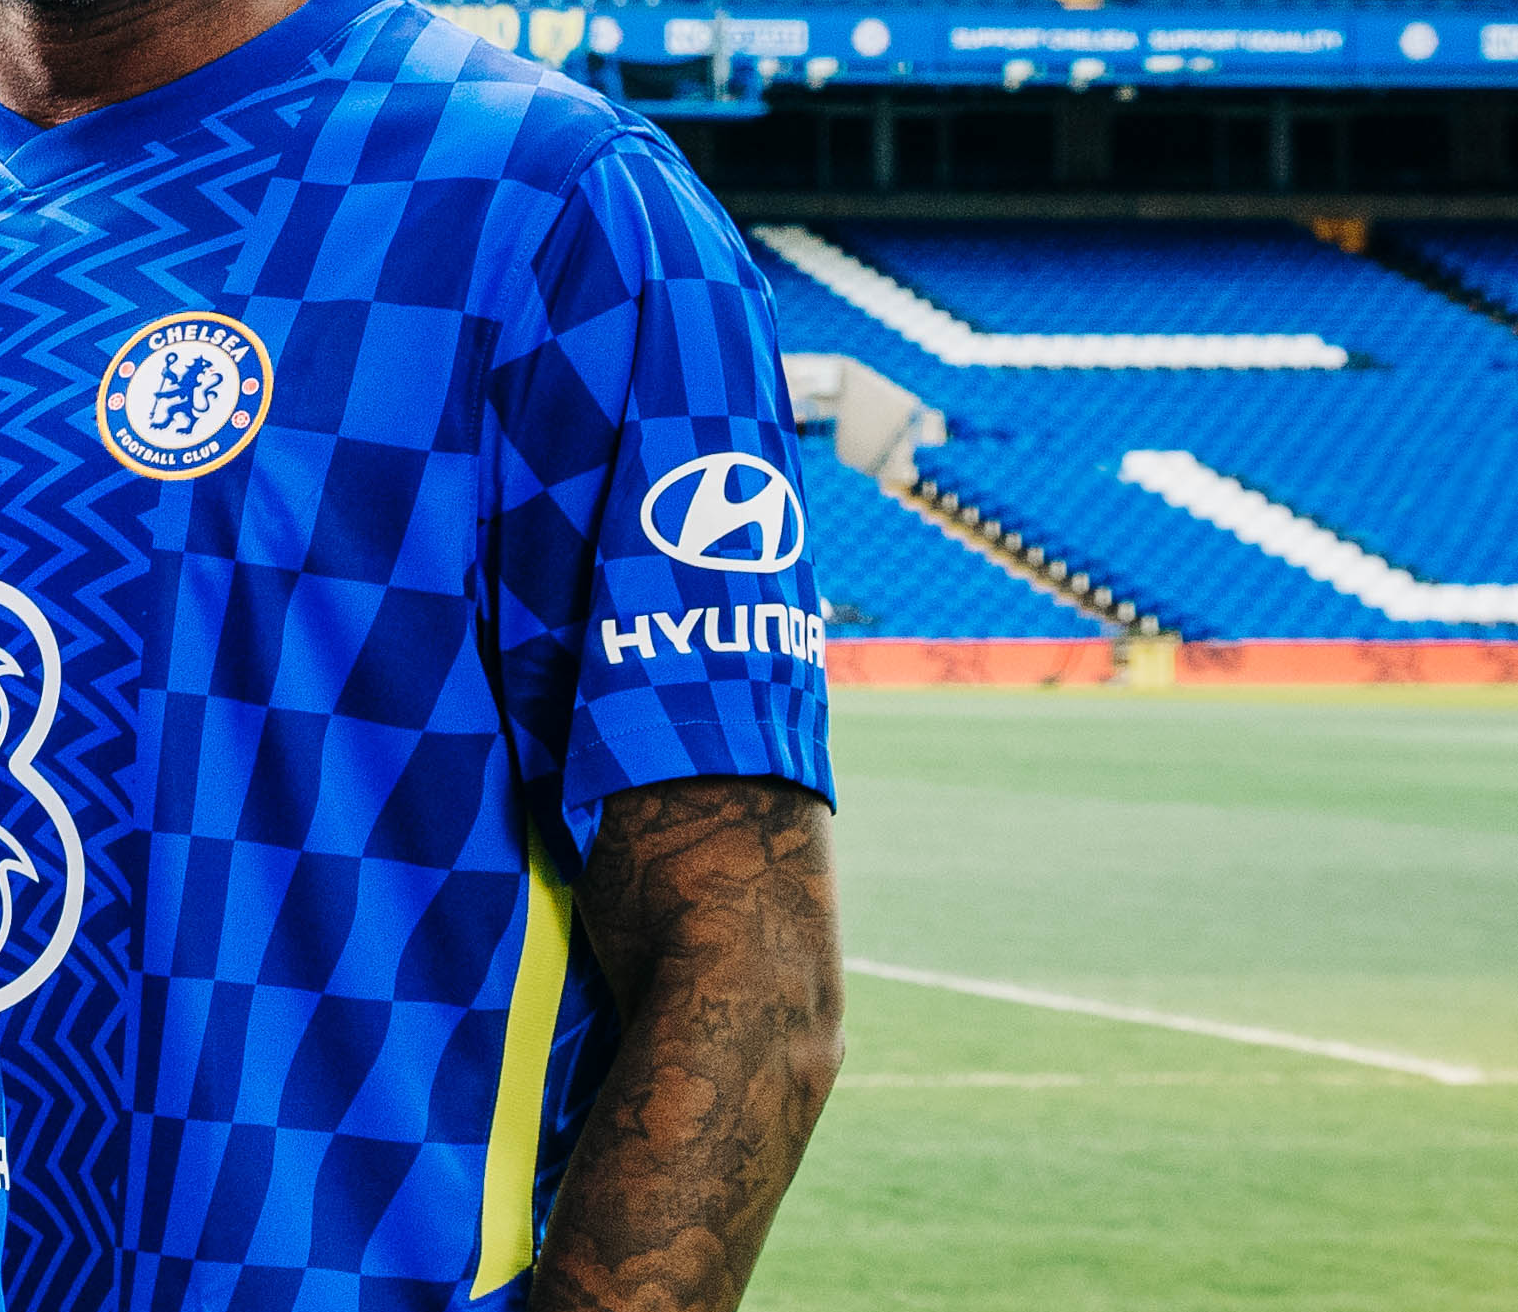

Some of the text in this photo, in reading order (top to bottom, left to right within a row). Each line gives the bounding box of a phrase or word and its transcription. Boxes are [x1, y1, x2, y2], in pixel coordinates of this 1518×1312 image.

[148, 324, 251, 364] CHELSEA
[115, 427, 221, 465] FOOTBALL CLUB
[601, 602, 824, 670] HYUNDA
